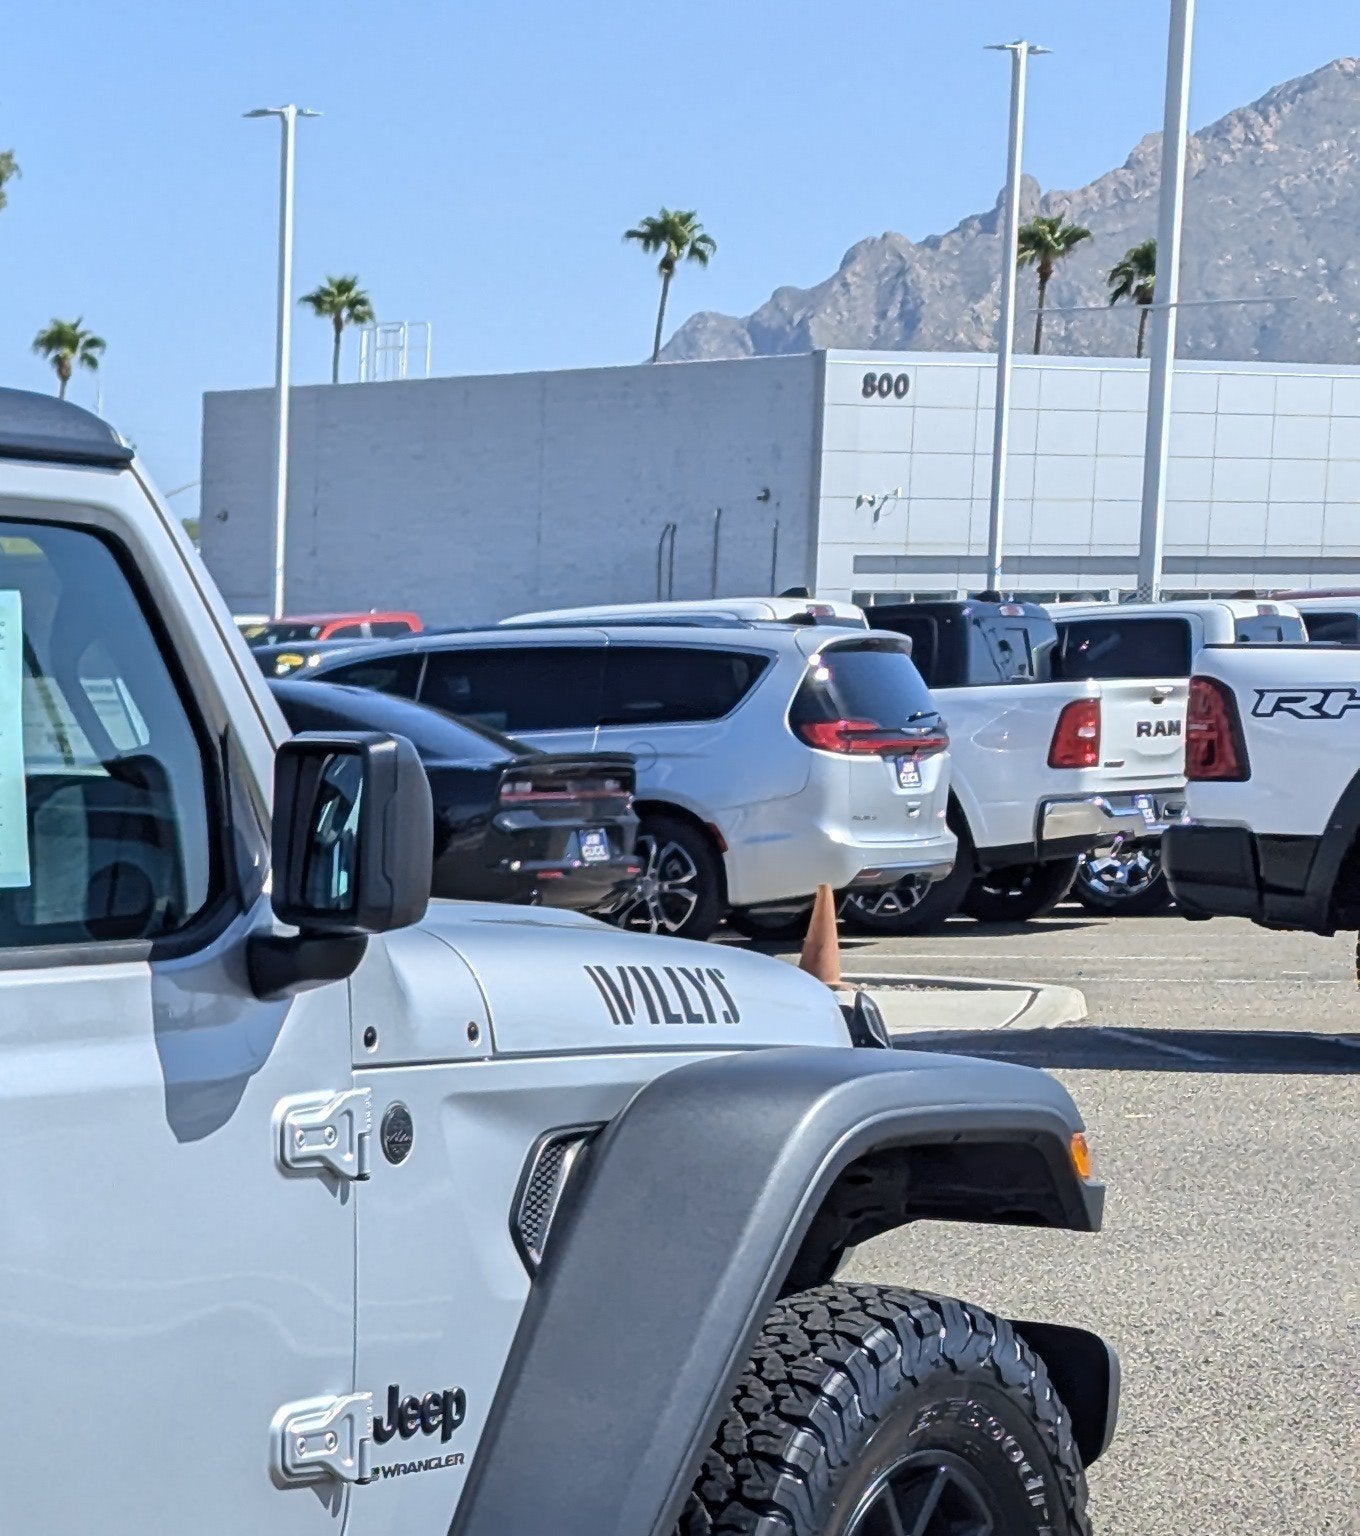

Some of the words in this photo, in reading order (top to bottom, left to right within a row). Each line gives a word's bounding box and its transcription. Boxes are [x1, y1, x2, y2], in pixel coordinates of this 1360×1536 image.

[862, 372, 910, 399] 800
[1136, 720, 1182, 738] RAM
[583, 965, 740, 1025] WILLYS
[372, 1384, 467, 1445] Jeep
[381, 1452, 465, 1478] WRANGLER
